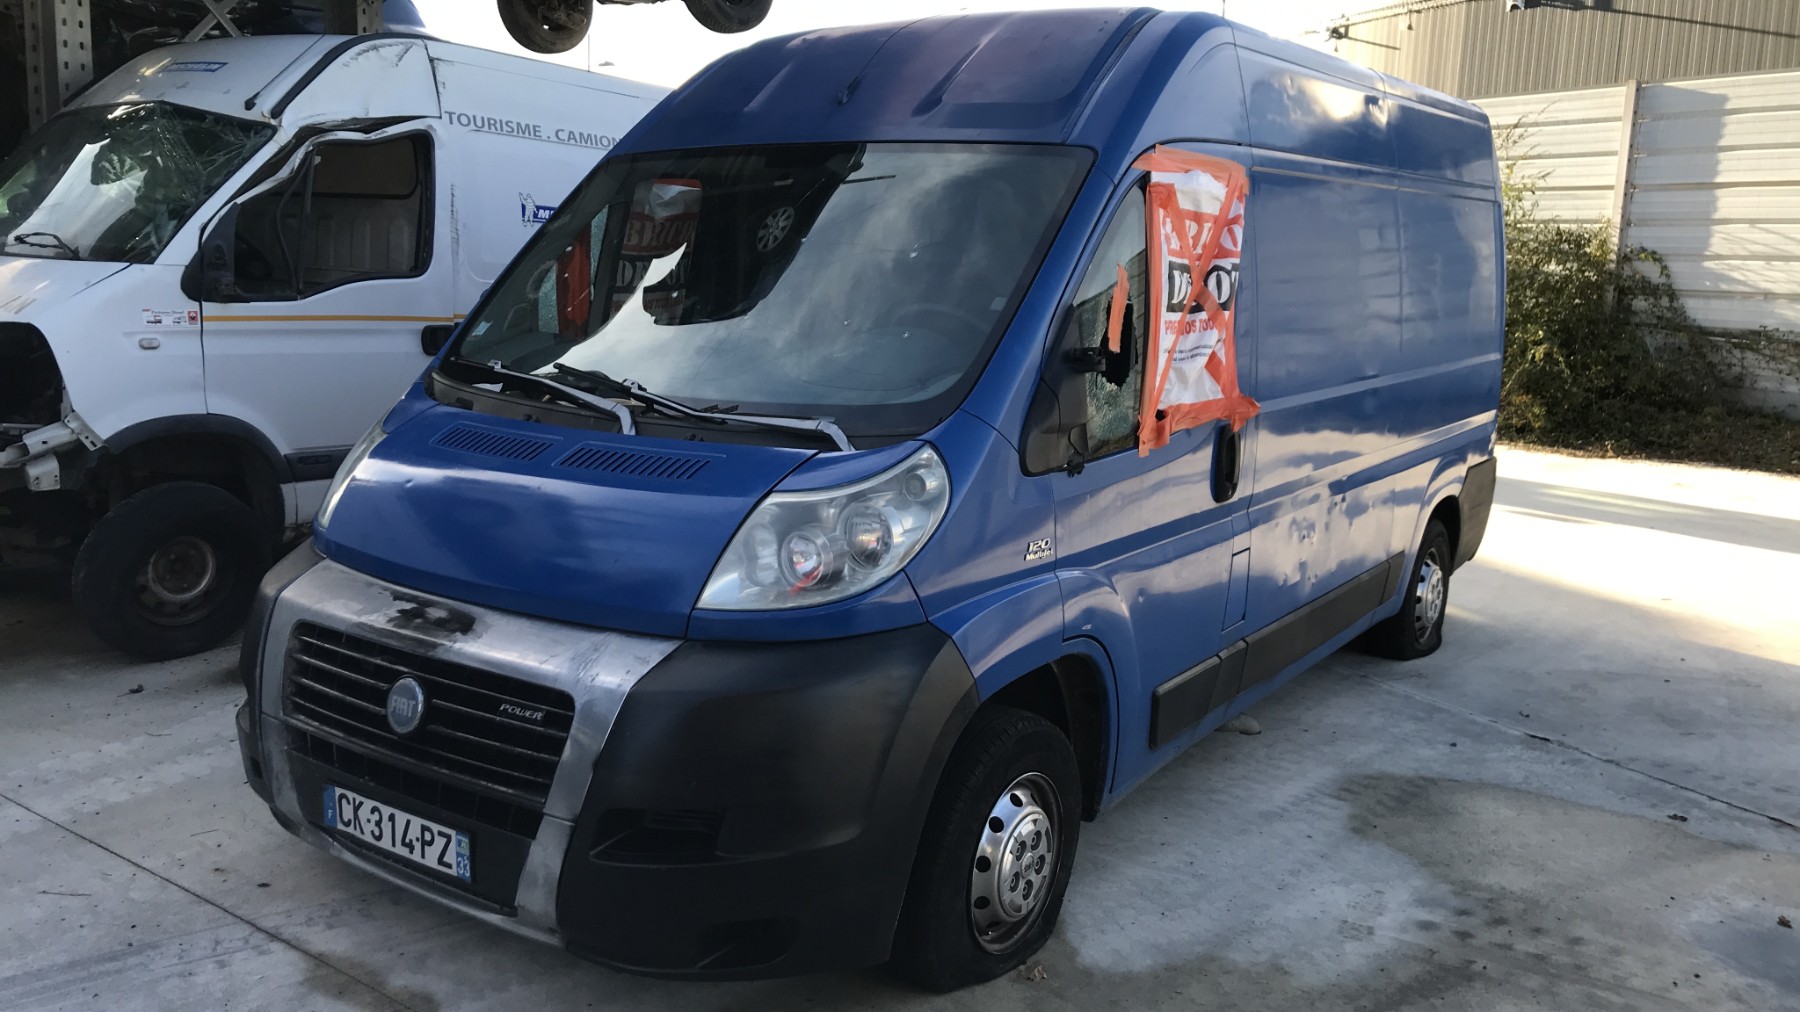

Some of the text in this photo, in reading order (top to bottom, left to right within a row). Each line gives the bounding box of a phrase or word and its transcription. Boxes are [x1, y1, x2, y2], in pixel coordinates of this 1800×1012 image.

[444, 110, 542, 139] TOURISME
[1027, 537, 1051, 552] 120
[390, 695, 416, 717] FIAT
[500, 703, 546, 721] POWER
[457, 856, 470, 877] 33
